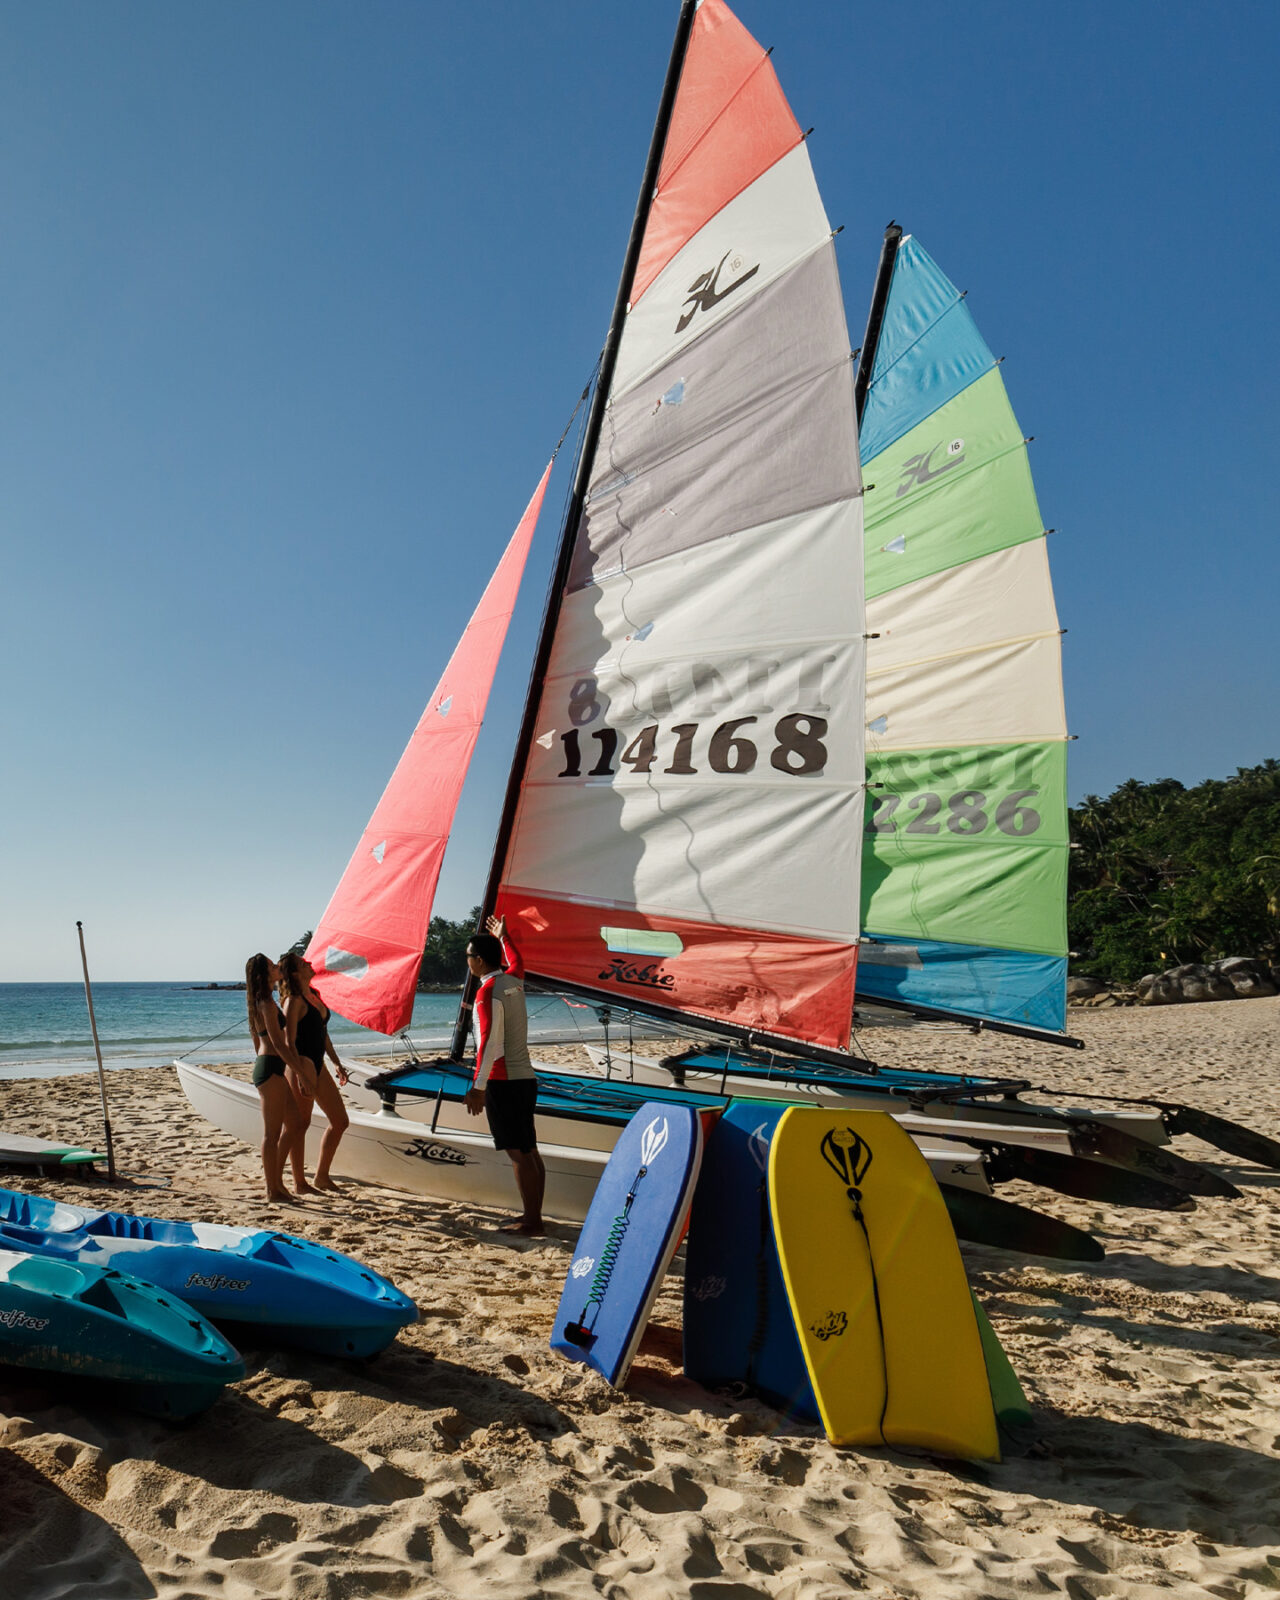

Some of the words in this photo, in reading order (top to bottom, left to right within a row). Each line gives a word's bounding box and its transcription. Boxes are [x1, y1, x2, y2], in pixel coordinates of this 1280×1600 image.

[730, 257, 742, 273] 16
[950, 441, 961, 453] 16
[557, 712, 829, 778] 114168
[864, 790, 1041, 837] 2286
[598, 958, 677, 992] Hobie
[400, 1138, 468, 1166] Hobie
[184, 1272, 249, 1291] feelfree
